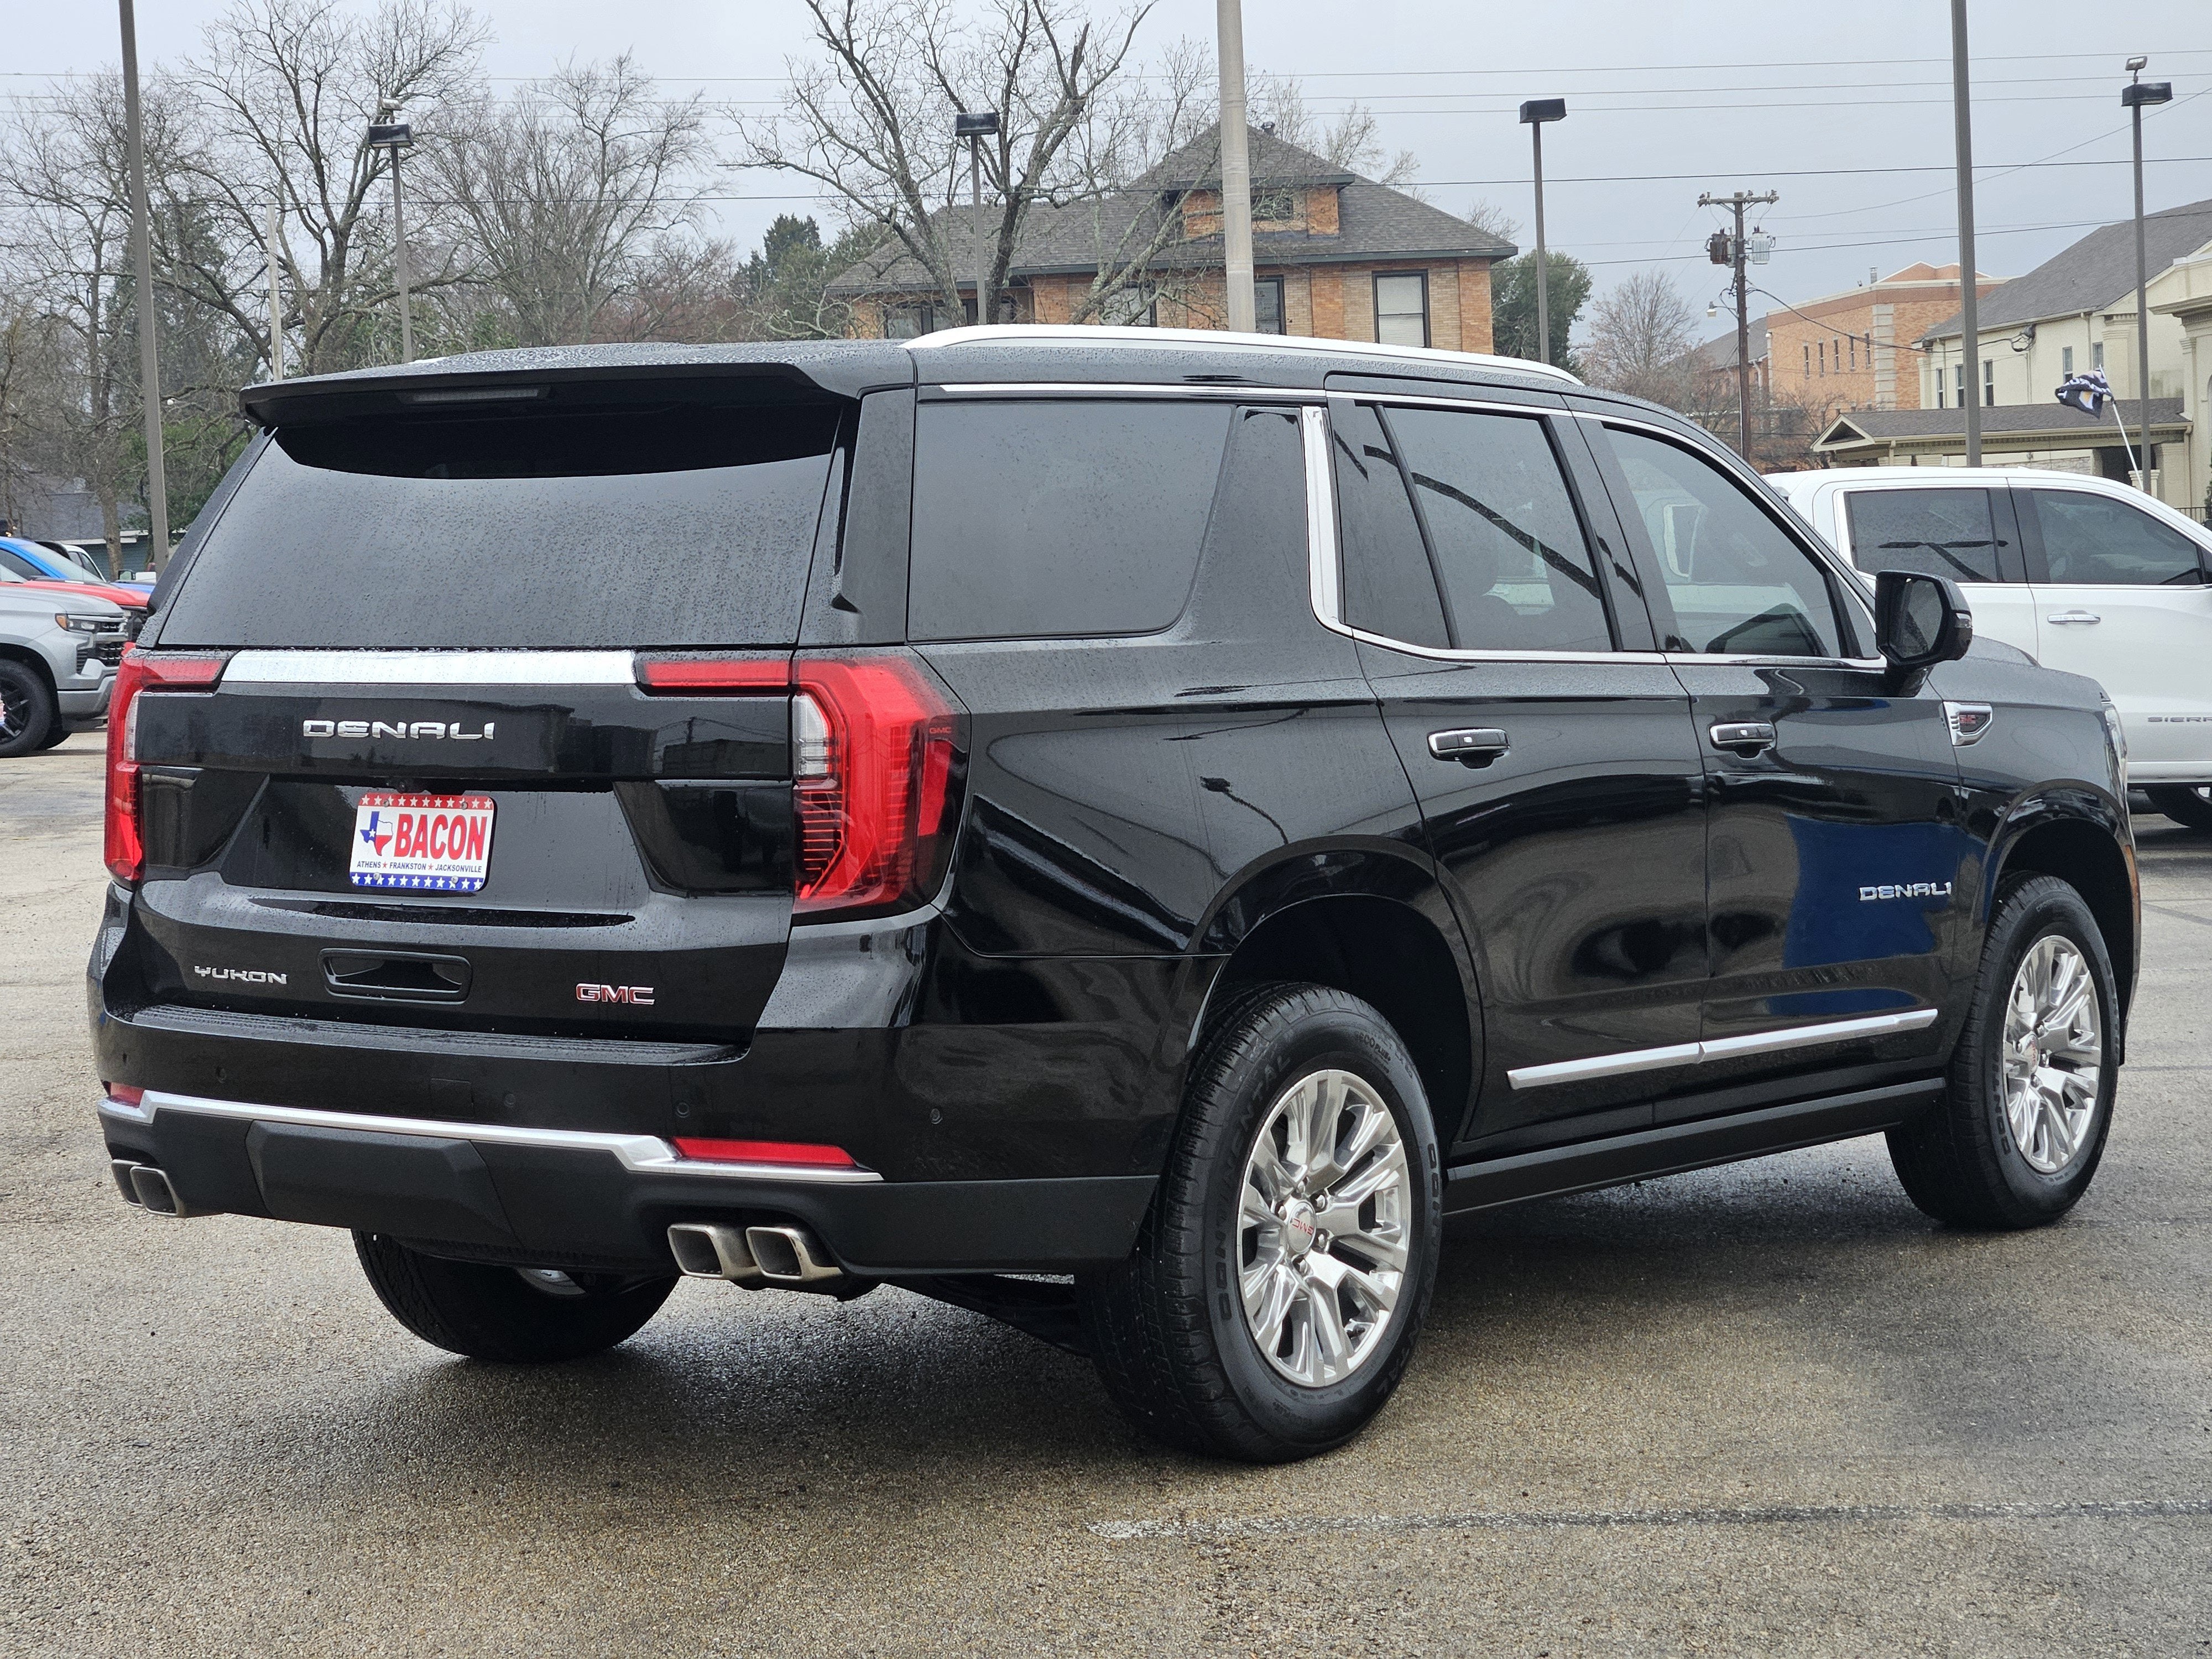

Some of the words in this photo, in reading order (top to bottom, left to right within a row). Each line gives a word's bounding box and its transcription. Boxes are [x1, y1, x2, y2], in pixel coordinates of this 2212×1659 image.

[303, 720, 495, 740] DENALI
[394, 814, 487, 860] BACON
[389, 862, 426, 870] FRANKSTON
[435, 864, 482, 873] JACKSONVILLE
[1859, 881, 1952, 901] DENALI
[194, 966, 287, 984] YUKON
[576, 983, 655, 1005] GMC
[1291, 1218, 1314, 1236] GMC
